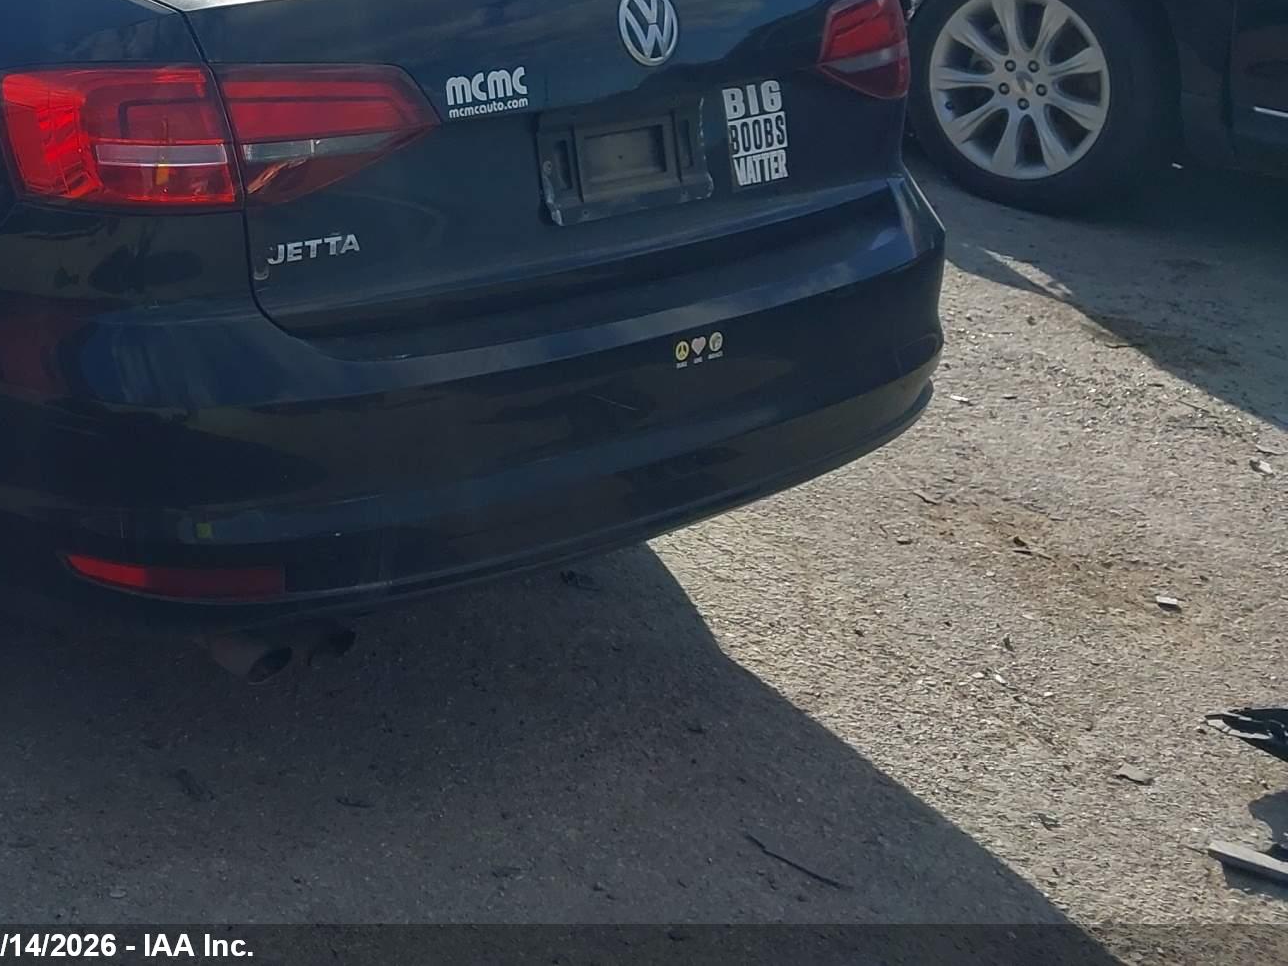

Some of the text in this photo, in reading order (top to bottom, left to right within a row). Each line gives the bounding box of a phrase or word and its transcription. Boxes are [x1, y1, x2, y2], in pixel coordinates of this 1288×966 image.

[448, 99, 529, 119] mcmcauto.com
[721, 79, 783, 120] BIG
[727, 112, 787, 155] BOOBS
[265, 232, 361, 265] JETTA
